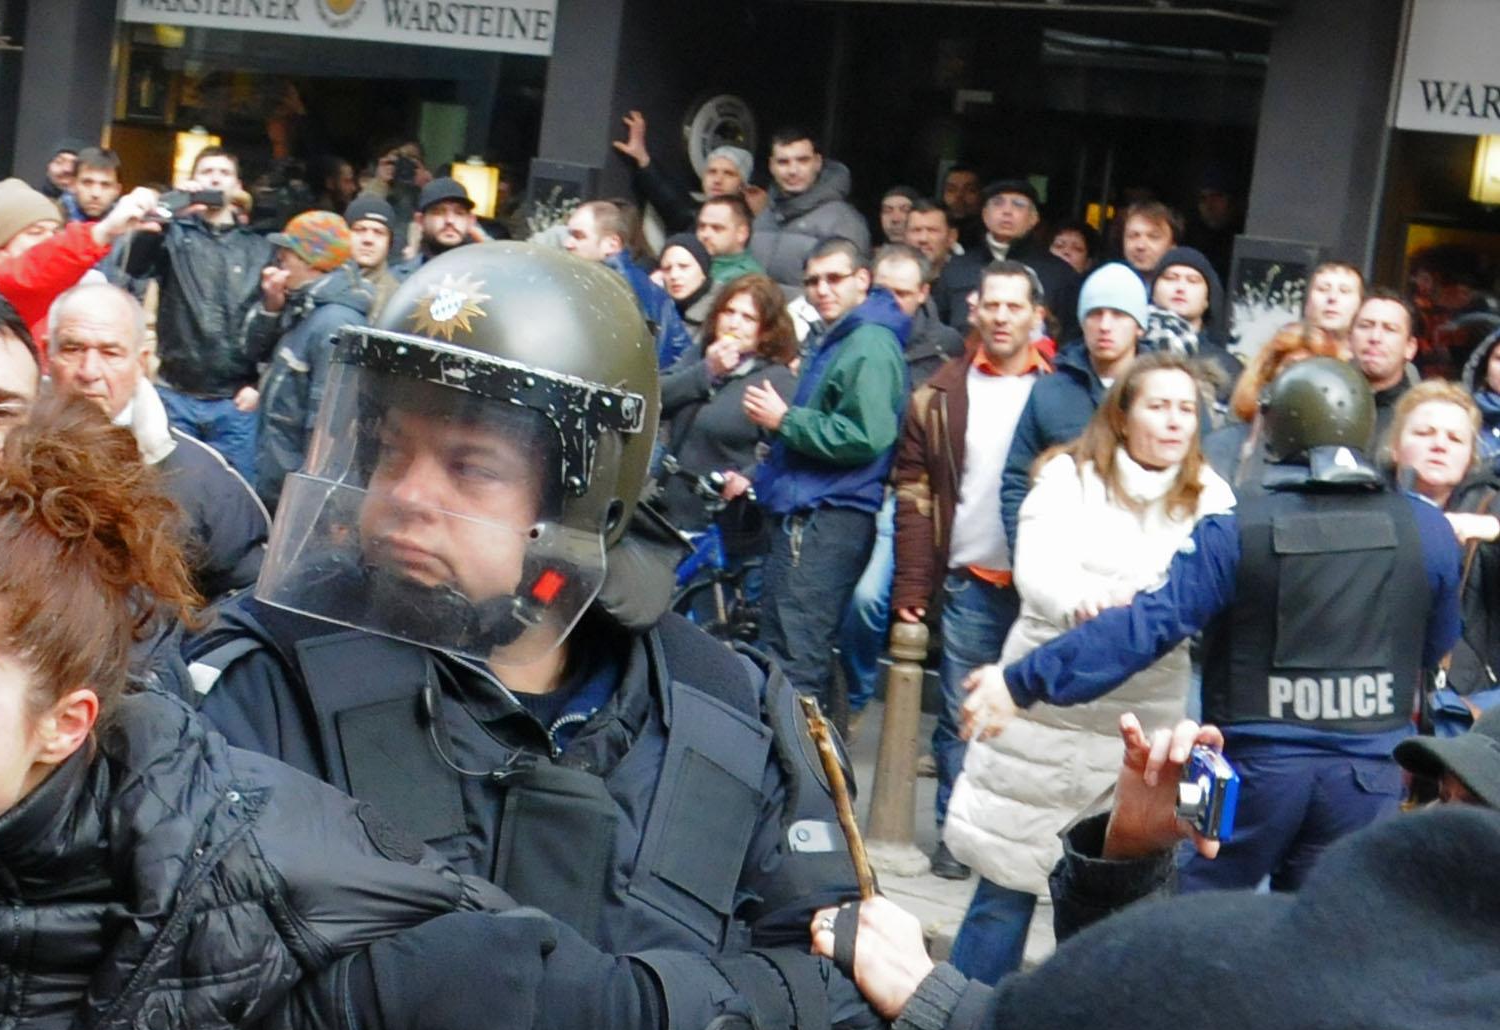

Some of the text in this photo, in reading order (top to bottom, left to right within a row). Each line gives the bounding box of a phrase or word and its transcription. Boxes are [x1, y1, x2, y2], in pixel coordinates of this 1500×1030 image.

[140, 0, 300, 20] STEINER
[1419, 79, 1500, 119] WAR
[1268, 673, 1395, 720] POLICE
